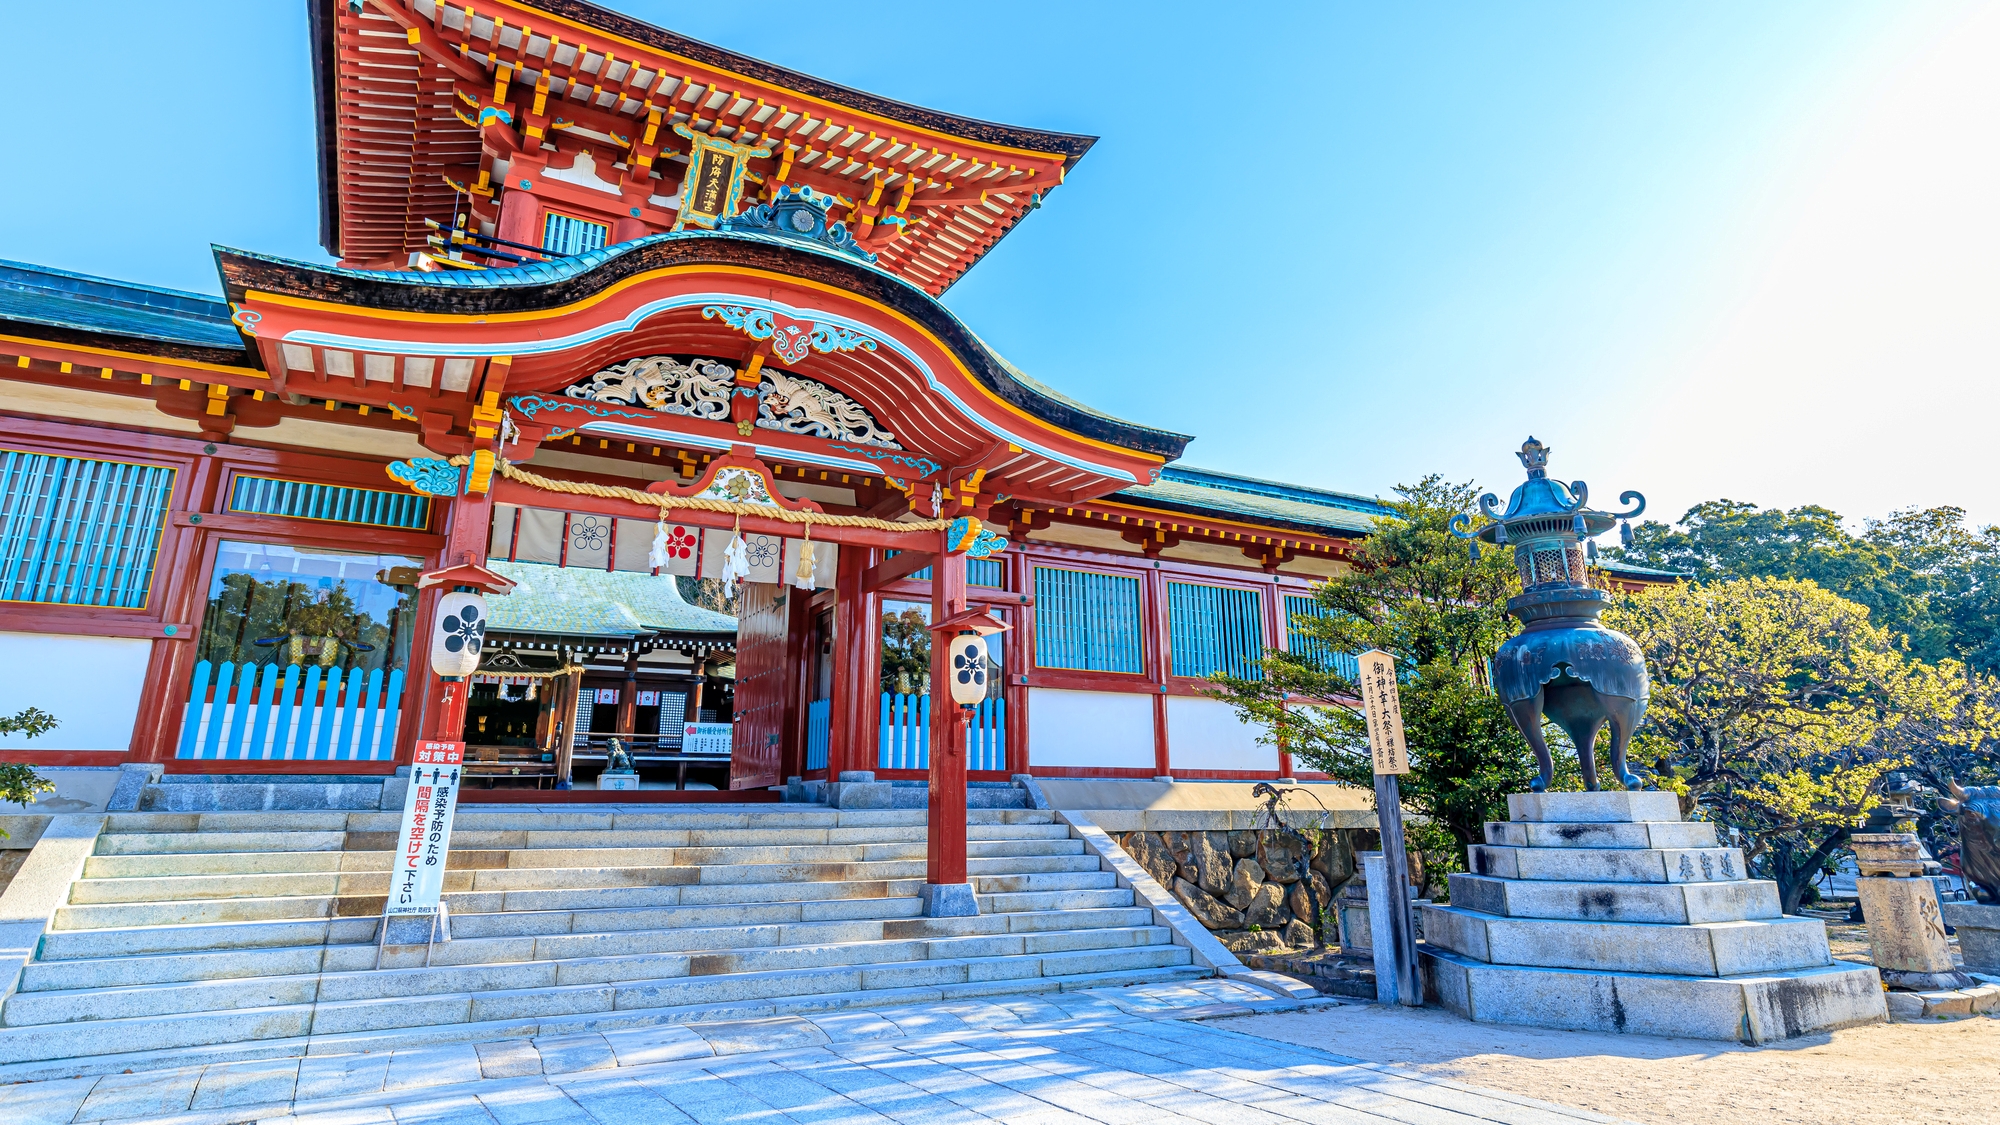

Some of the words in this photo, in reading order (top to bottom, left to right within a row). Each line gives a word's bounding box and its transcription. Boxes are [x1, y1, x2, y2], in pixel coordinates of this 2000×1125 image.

[704, 154, 725, 212] 防府天満宮
[1386, 668, 1399, 714] 令和四年度
[418, 751, 459, 763] 対策中
[425, 743, 455, 751] 感染予防
[400, 786, 432, 904] 間隔を空けて下さい
[425, 786, 449, 866] 感染予防のため
